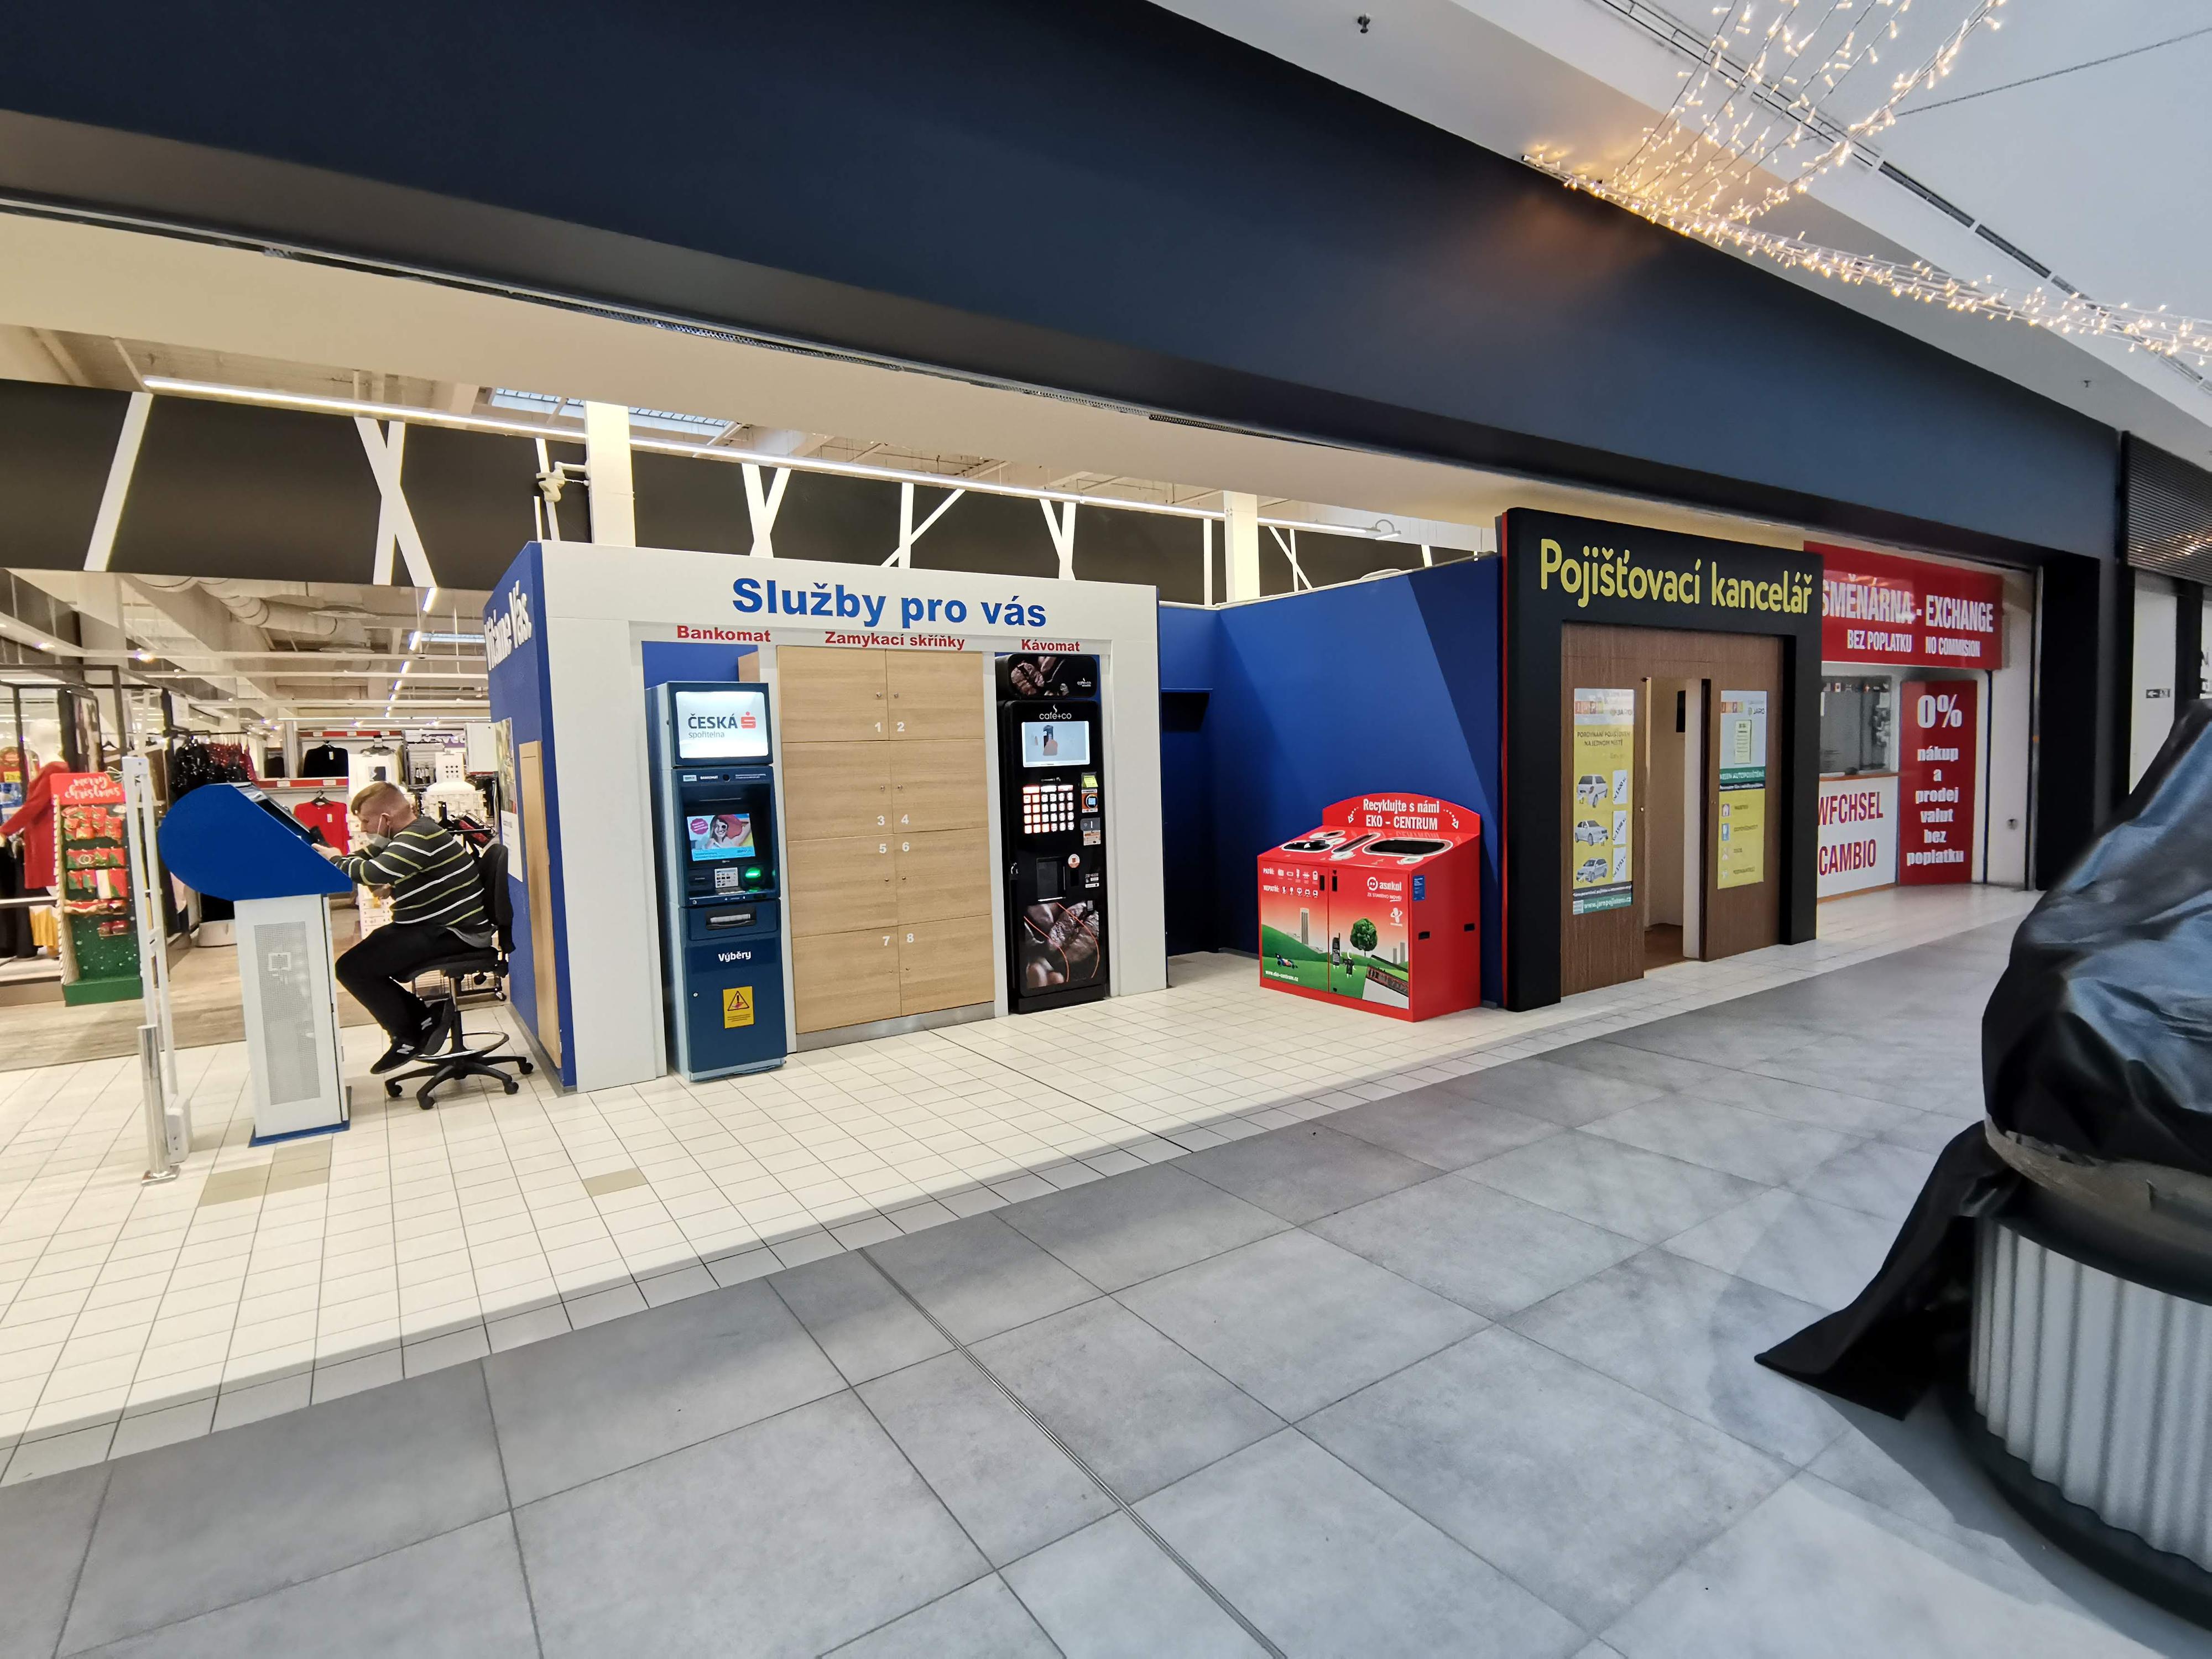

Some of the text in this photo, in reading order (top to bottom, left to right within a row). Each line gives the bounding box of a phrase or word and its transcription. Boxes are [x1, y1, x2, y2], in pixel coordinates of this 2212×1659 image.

[1541, 539, 1812, 614] Pojišťovací kancelář
[732, 578, 1046, 629] Služby pro vás
[1823, 573, 1912, 624] SMĚNÁRNA
[1926, 594, 1993, 633] EXCHANGE
[677, 625, 770, 642] Bankomat
[825, 631, 966, 651] Zamykací skříňky
[1847, 629, 1912, 653] BEZ POPLATKU
[1021, 638, 1080, 652] Kávomat
[1925, 636, 1937, 655] NO
[1917, 694, 1962, 728] 0%
[688, 713, 738, 729] ČESKÁ
[875, 722, 881, 732] 1
[897, 722, 905, 732] 2
[688, 731, 725, 739] spořitelna
[1917, 745, 1959, 761] nákup
[1933, 769, 1942, 781] a
[1915, 786, 1959, 804] prodej
[1363, 798, 1440, 815] Recyklujte s námi
[877, 815, 885, 826] 3
[901, 814, 909, 824] 4
[1366, 814, 1383, 827] EKO
[1394, 816, 1438, 831] CENTRUM
[1920, 808, 1953, 823] valut
[1923, 829, 1947, 843] bez
[879, 843, 887, 854] 5
[902, 842, 910, 852] 6
[1819, 838, 1876, 875] CAMBIO
[1907, 848, 1964, 867] poplatku
[883, 936, 890, 946] 7
[906, 933, 914, 943] 8
[718, 951, 752, 963] Výběry
